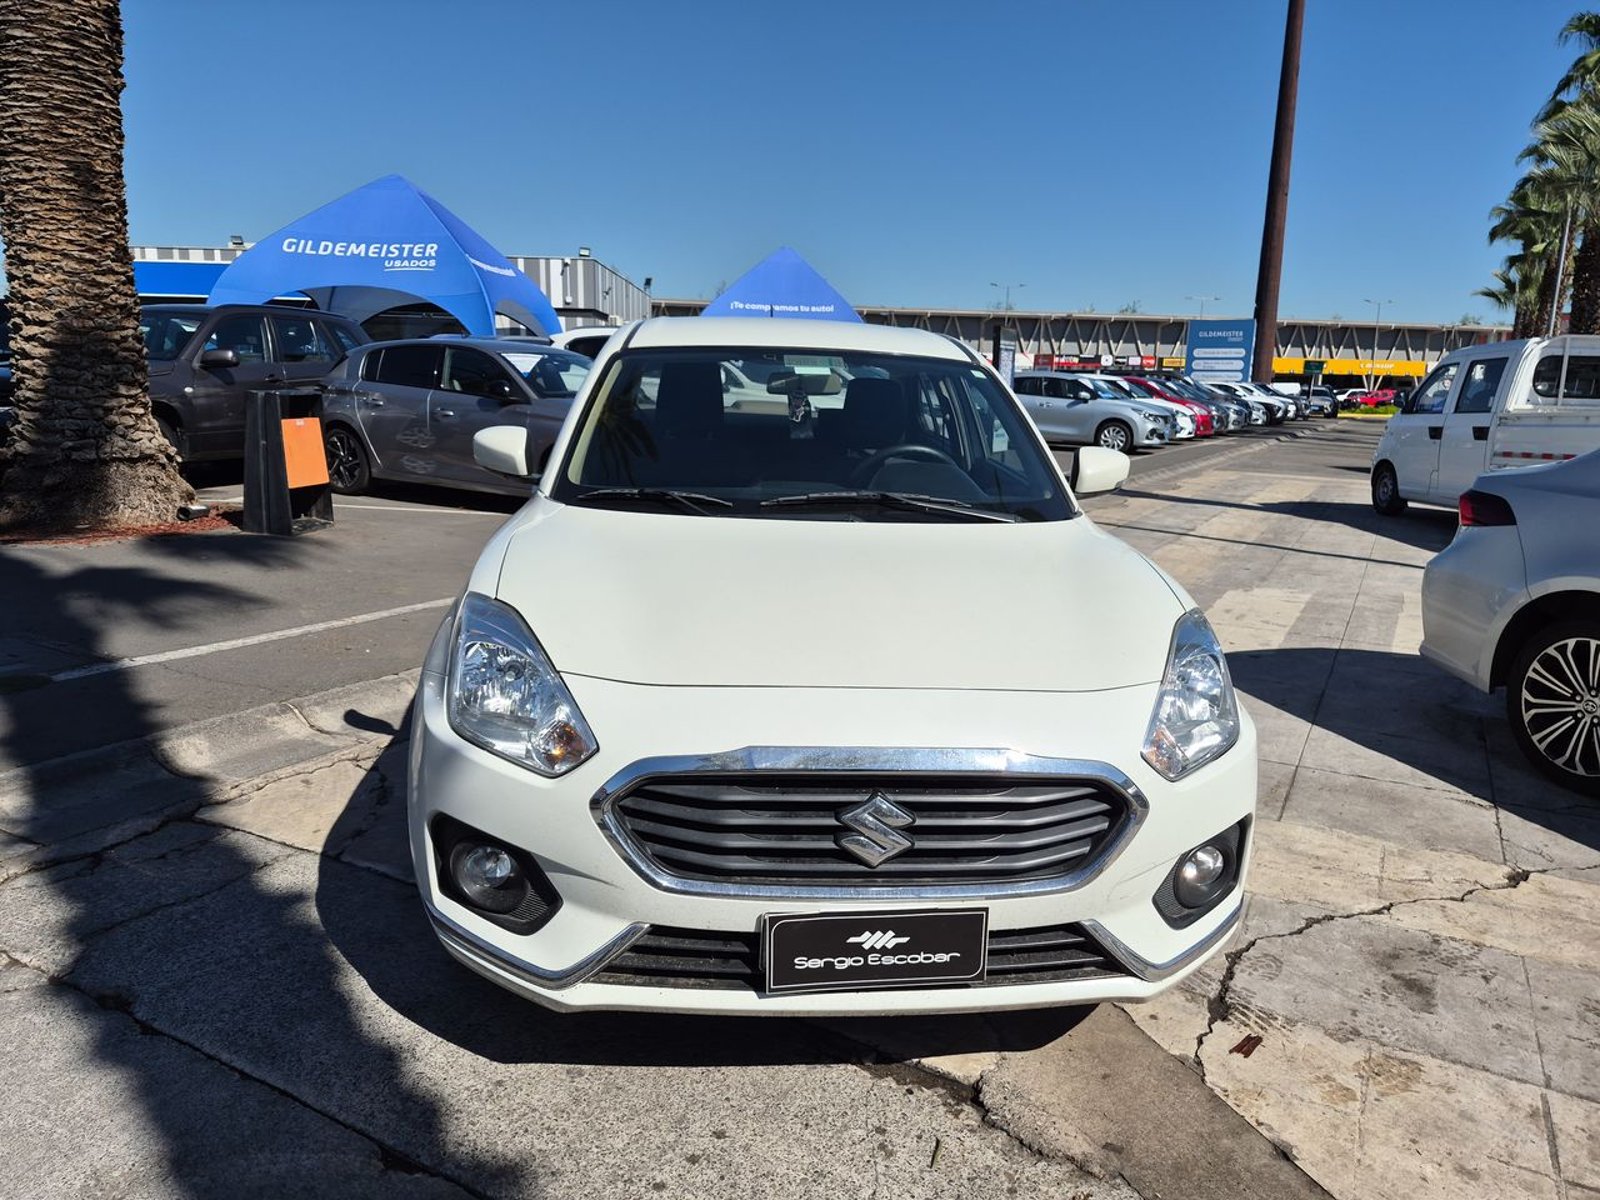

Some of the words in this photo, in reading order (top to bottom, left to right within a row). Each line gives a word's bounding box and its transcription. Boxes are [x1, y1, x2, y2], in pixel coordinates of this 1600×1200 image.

[282, 238, 438, 258] GILDEMEISTER
[384, 259, 437, 267] USADOS
[794, 956, 864, 970] Sergio
[867, 951, 961, 965] Escobar
